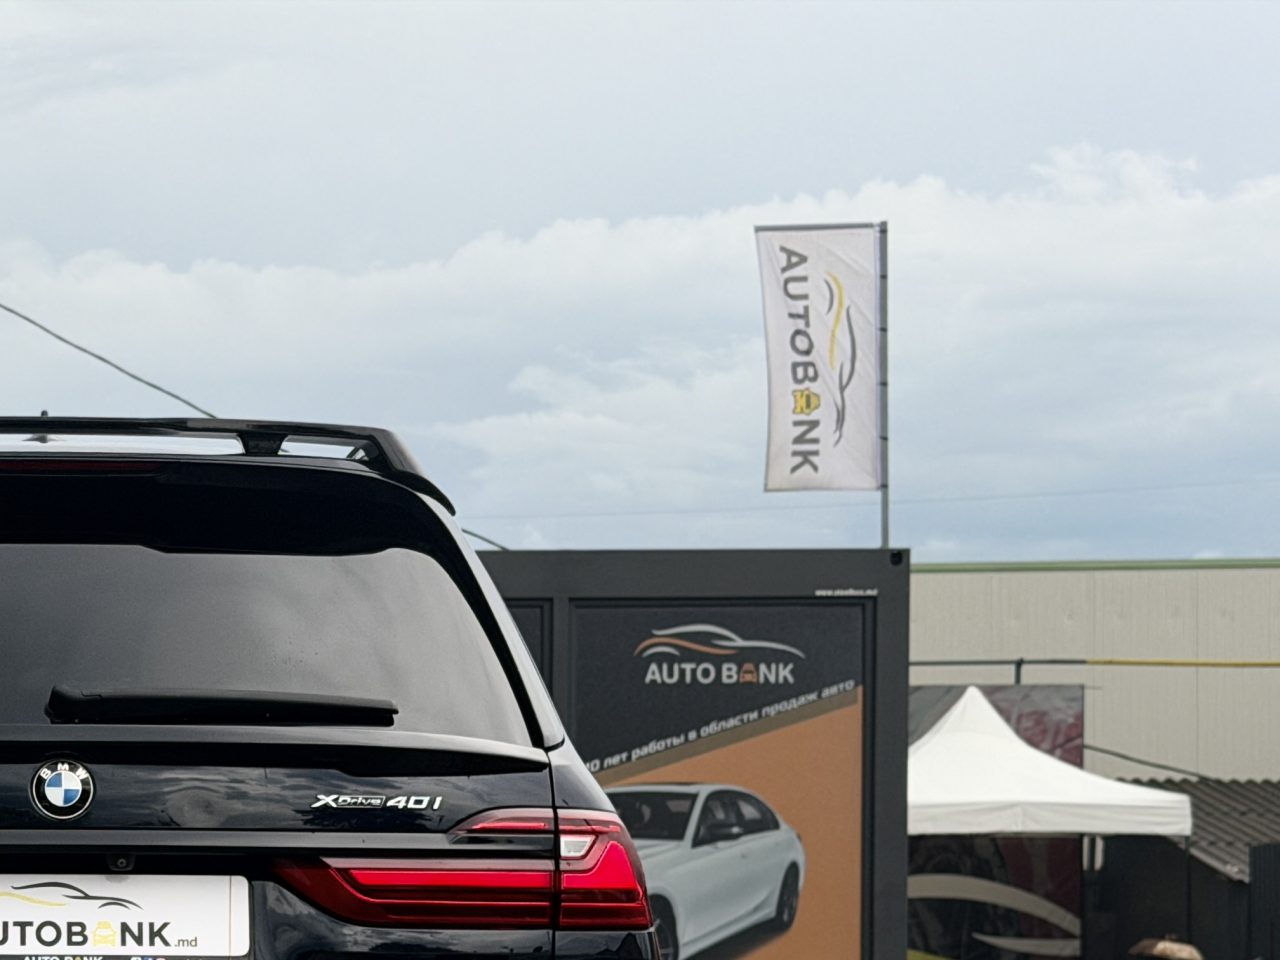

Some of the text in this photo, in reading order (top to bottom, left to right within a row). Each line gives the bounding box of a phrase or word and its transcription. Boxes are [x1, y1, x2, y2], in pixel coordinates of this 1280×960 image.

[645, 662, 716, 684] AUTO
[603, 752, 629, 769] лет
[631, 734, 684, 761] работы
[688, 731, 698, 742] в
[700, 711, 759, 739] области
[761, 691, 819, 718] продаж
[821, 680, 855, 698] авто
[40, 762, 90, 780] BMW
